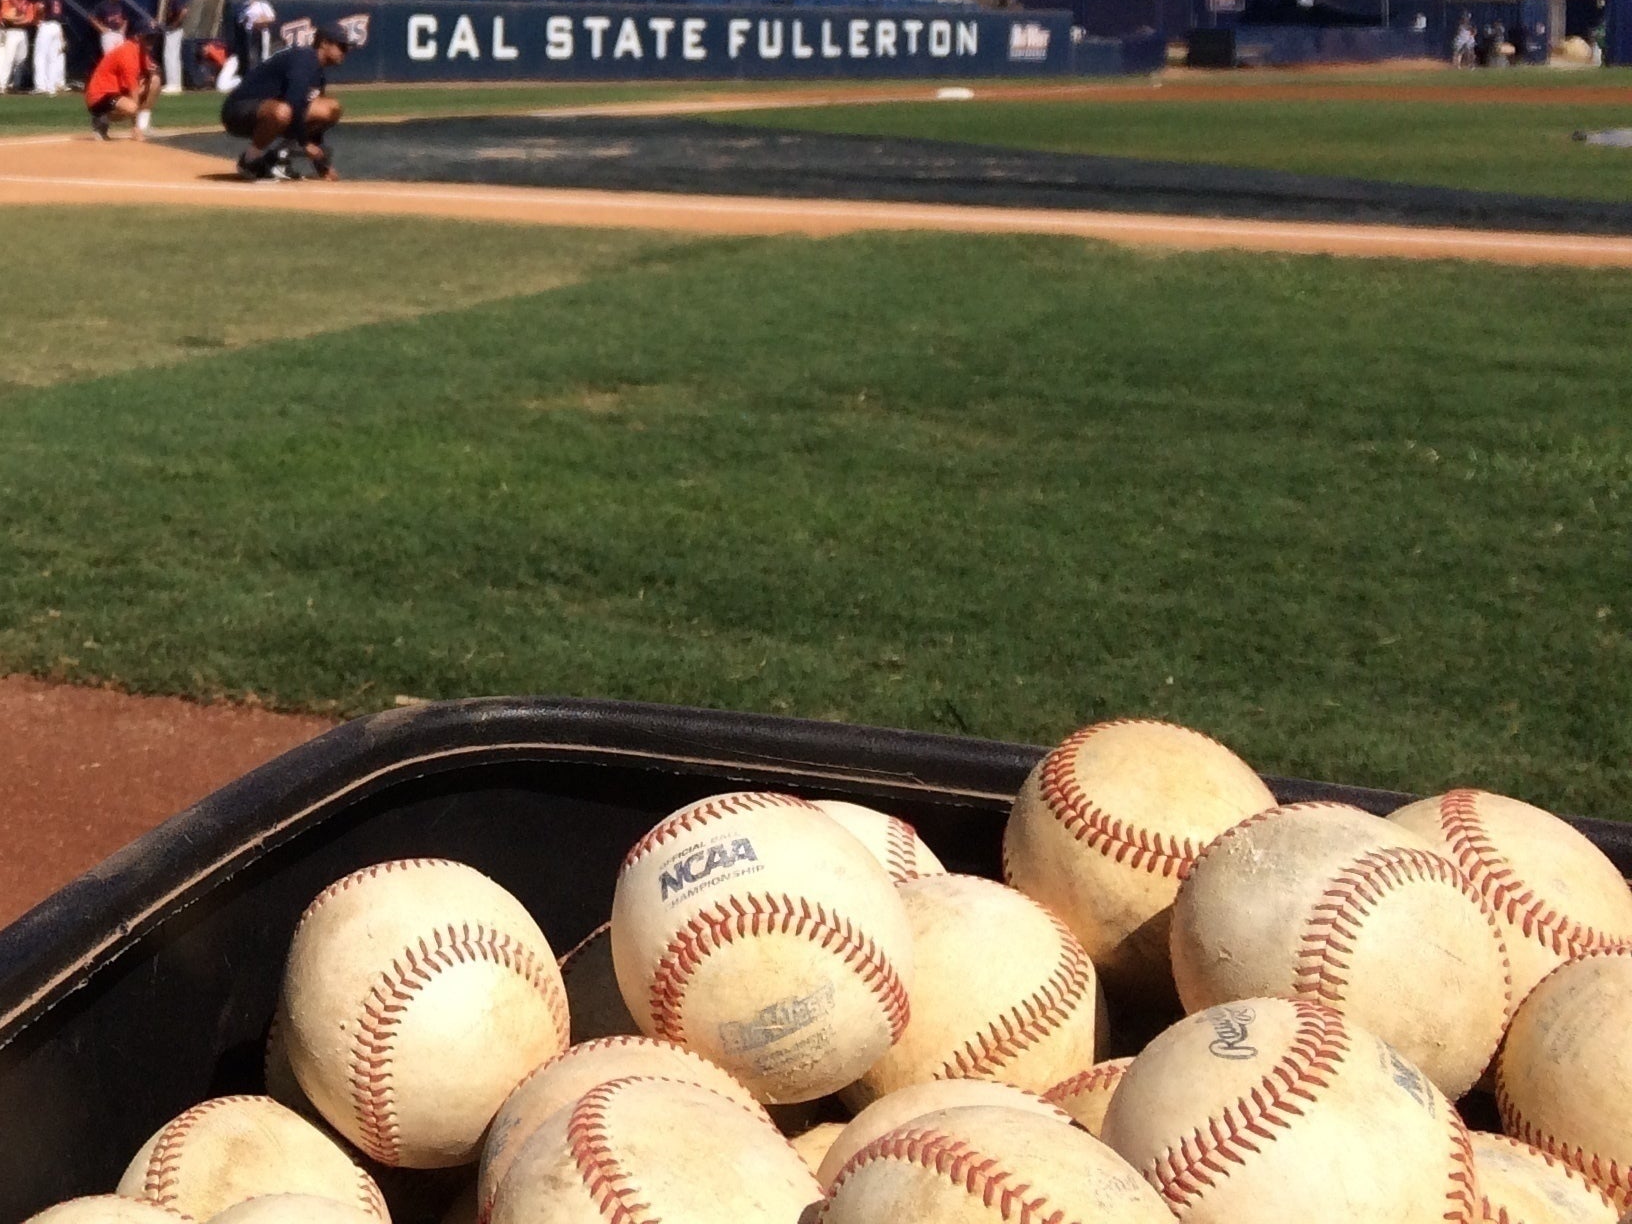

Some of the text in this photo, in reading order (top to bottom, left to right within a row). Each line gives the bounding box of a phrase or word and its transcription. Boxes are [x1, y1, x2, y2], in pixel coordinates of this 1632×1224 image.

[407, 14, 519, 60] CAL
[545, 15, 707, 60] STATE
[728, 18, 978, 59] FULLERTON
[659, 837, 758, 902] NCAA
[667, 864, 765, 909] HAMPIONSHIP
